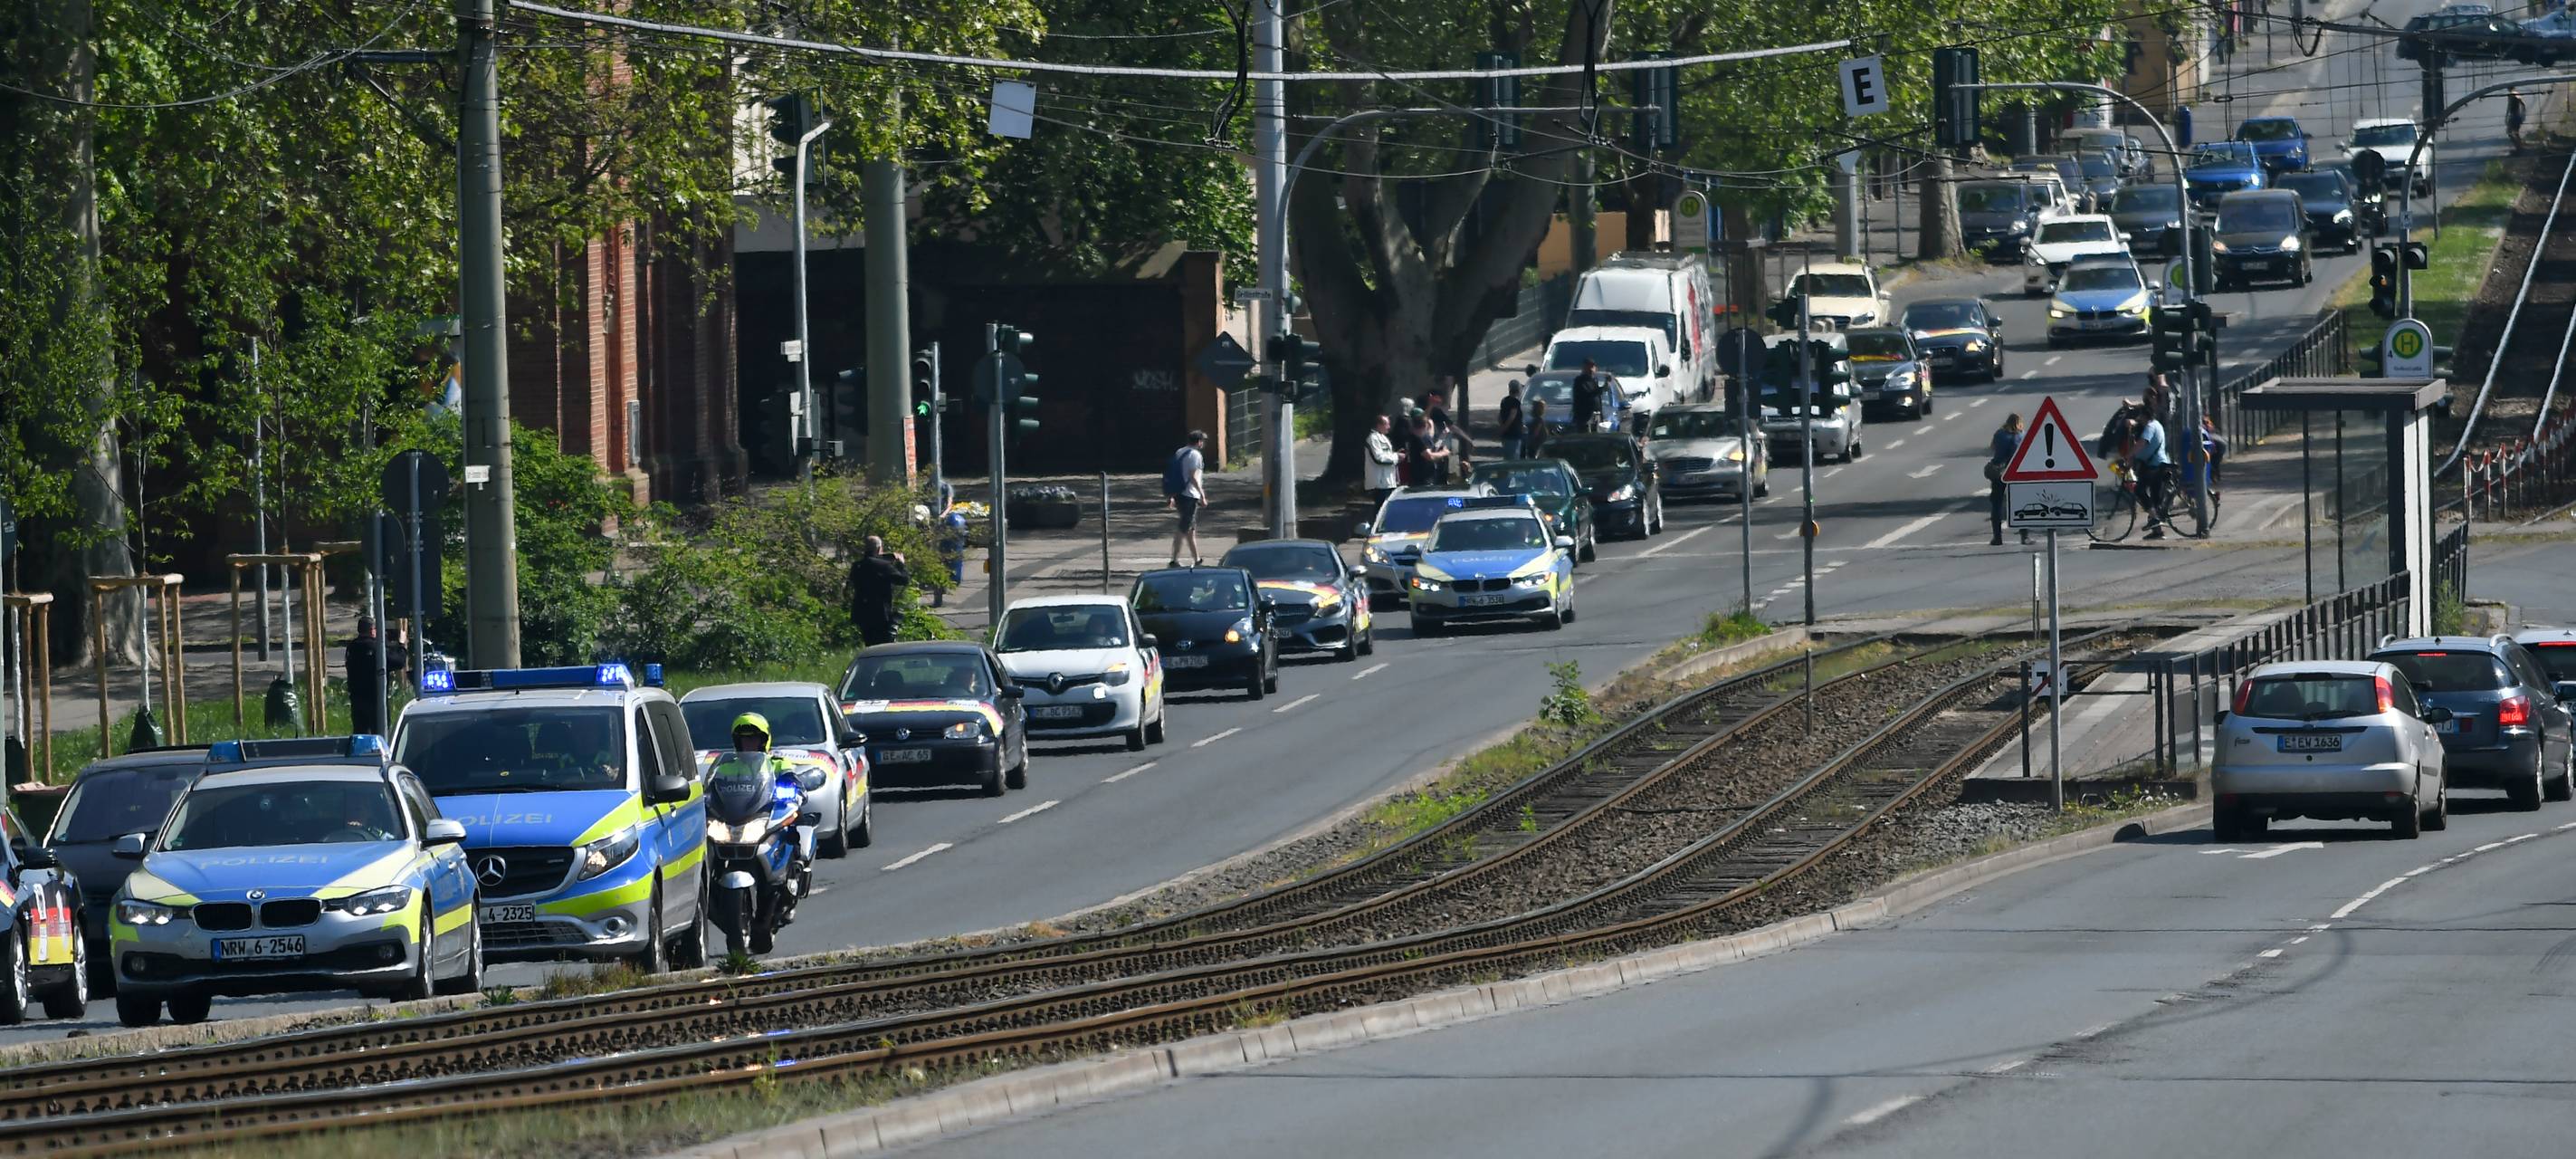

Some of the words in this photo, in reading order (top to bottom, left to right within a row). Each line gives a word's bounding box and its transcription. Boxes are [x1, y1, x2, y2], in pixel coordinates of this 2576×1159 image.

[1852, 67, 1875, 105] E
[2400, 335, 2413, 352] H
[2387, 350, 2393, 359] 4
[2285, 738, 2291, 748] E
[2298, 737, 2311, 748] EW
[2314, 736, 2340, 748] 1636
[455, 812, 553, 827] OLIZEI
[200, 855, 328, 869] POLIZEI
[489, 906, 532, 922] 4-2325
[220, 941, 245, 957] NRW
[254, 936, 303, 955] 6-2546
